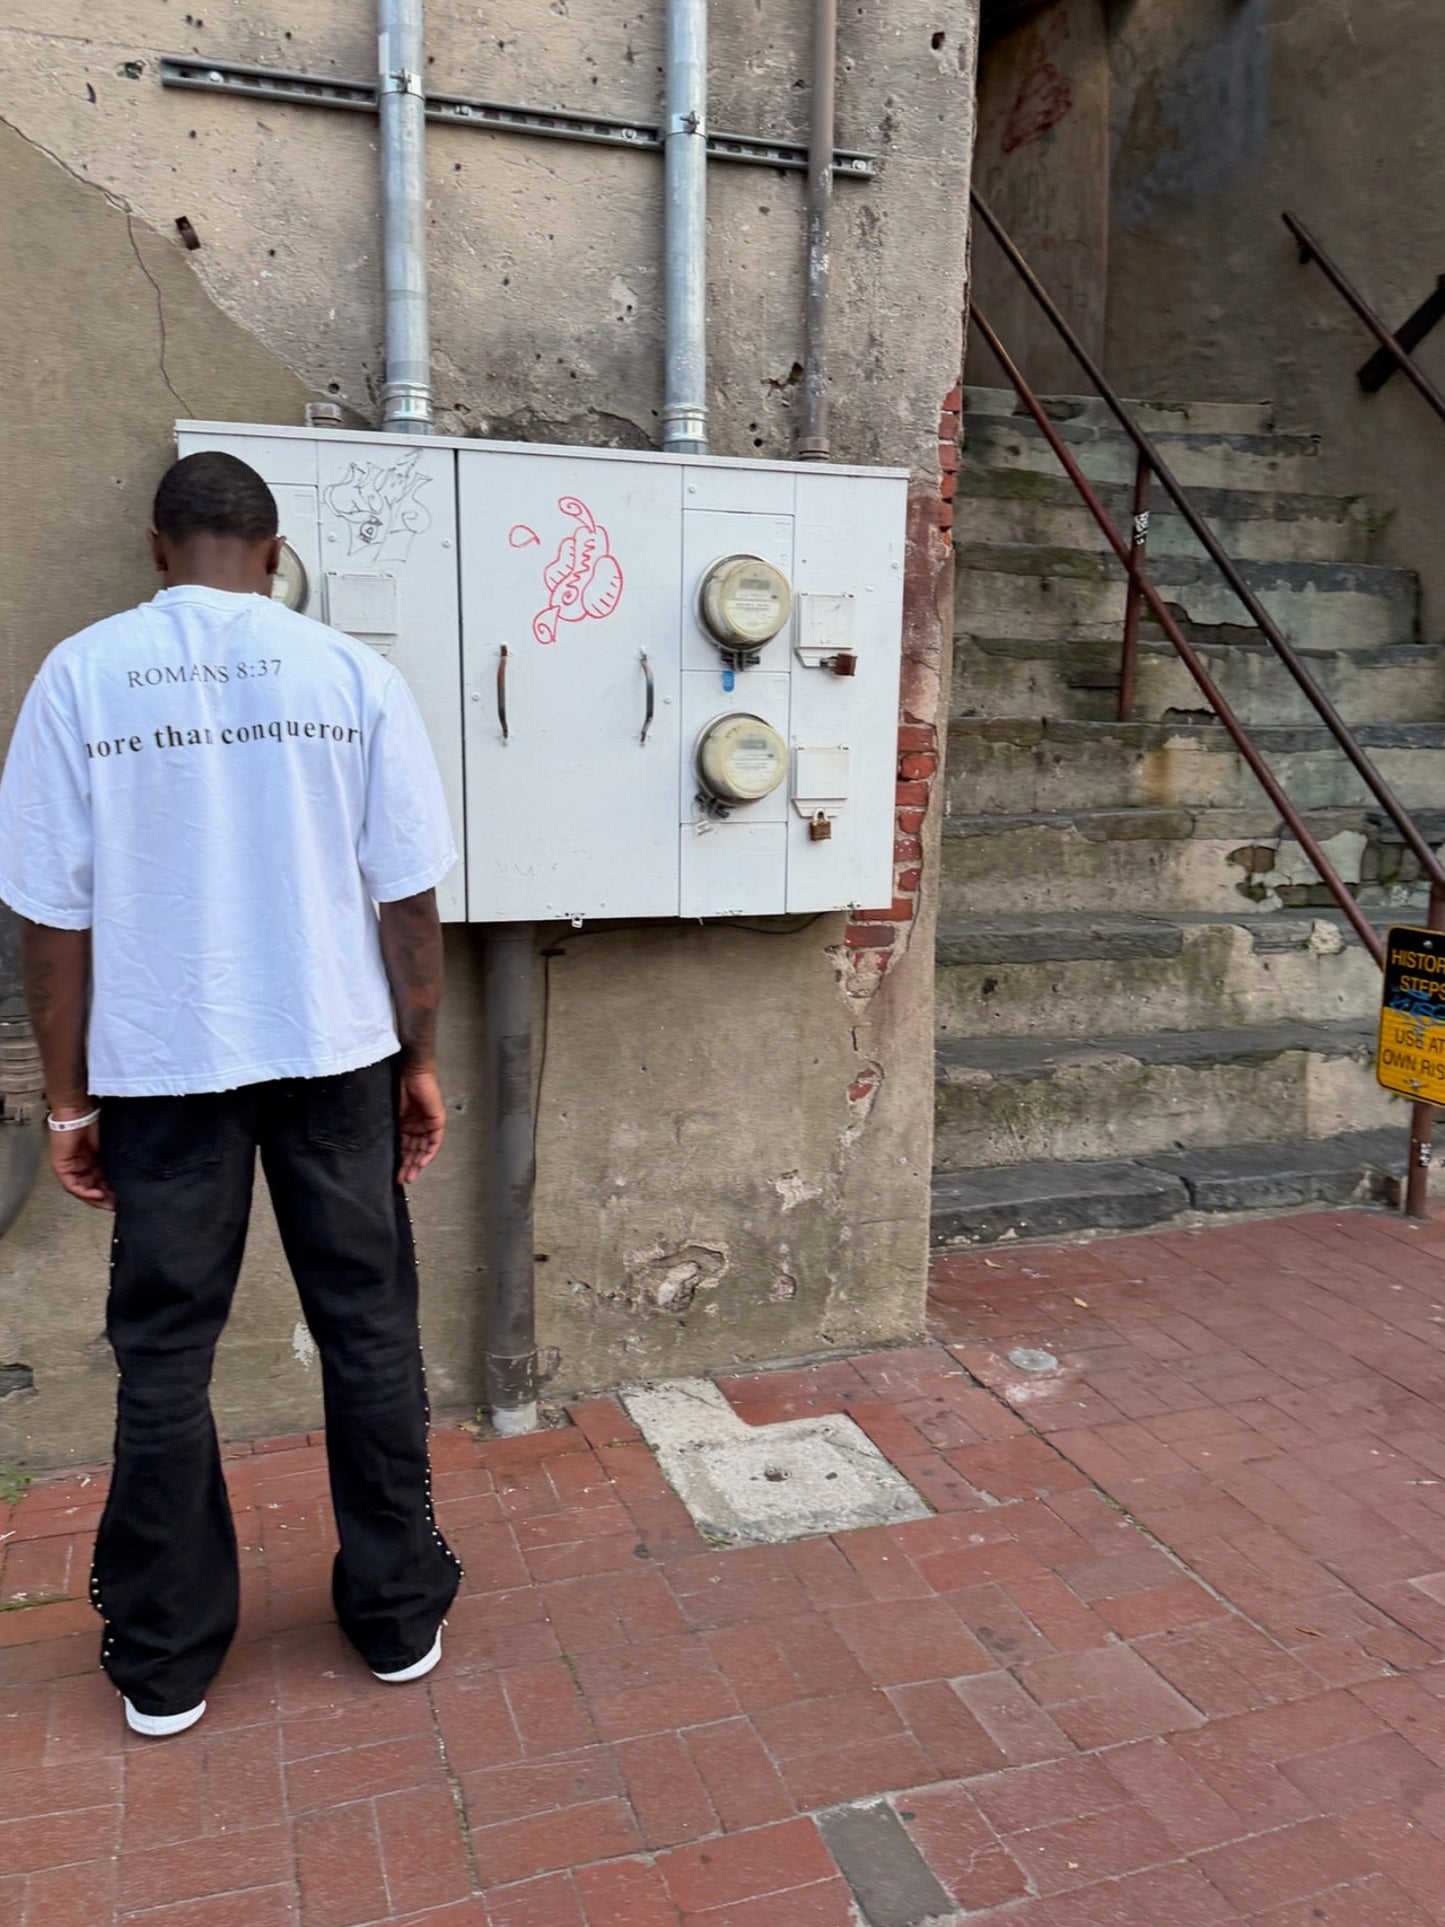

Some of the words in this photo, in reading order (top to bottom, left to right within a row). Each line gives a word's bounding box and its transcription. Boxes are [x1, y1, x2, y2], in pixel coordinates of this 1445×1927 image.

[127, 663, 230, 688] ROMANS
[236, 659, 283, 680] 8:37
[1395, 1027, 1425, 1050] USE
[1428, 1037, 1445, 1054] AT
[1382, 1048, 1417, 1071] OWN
